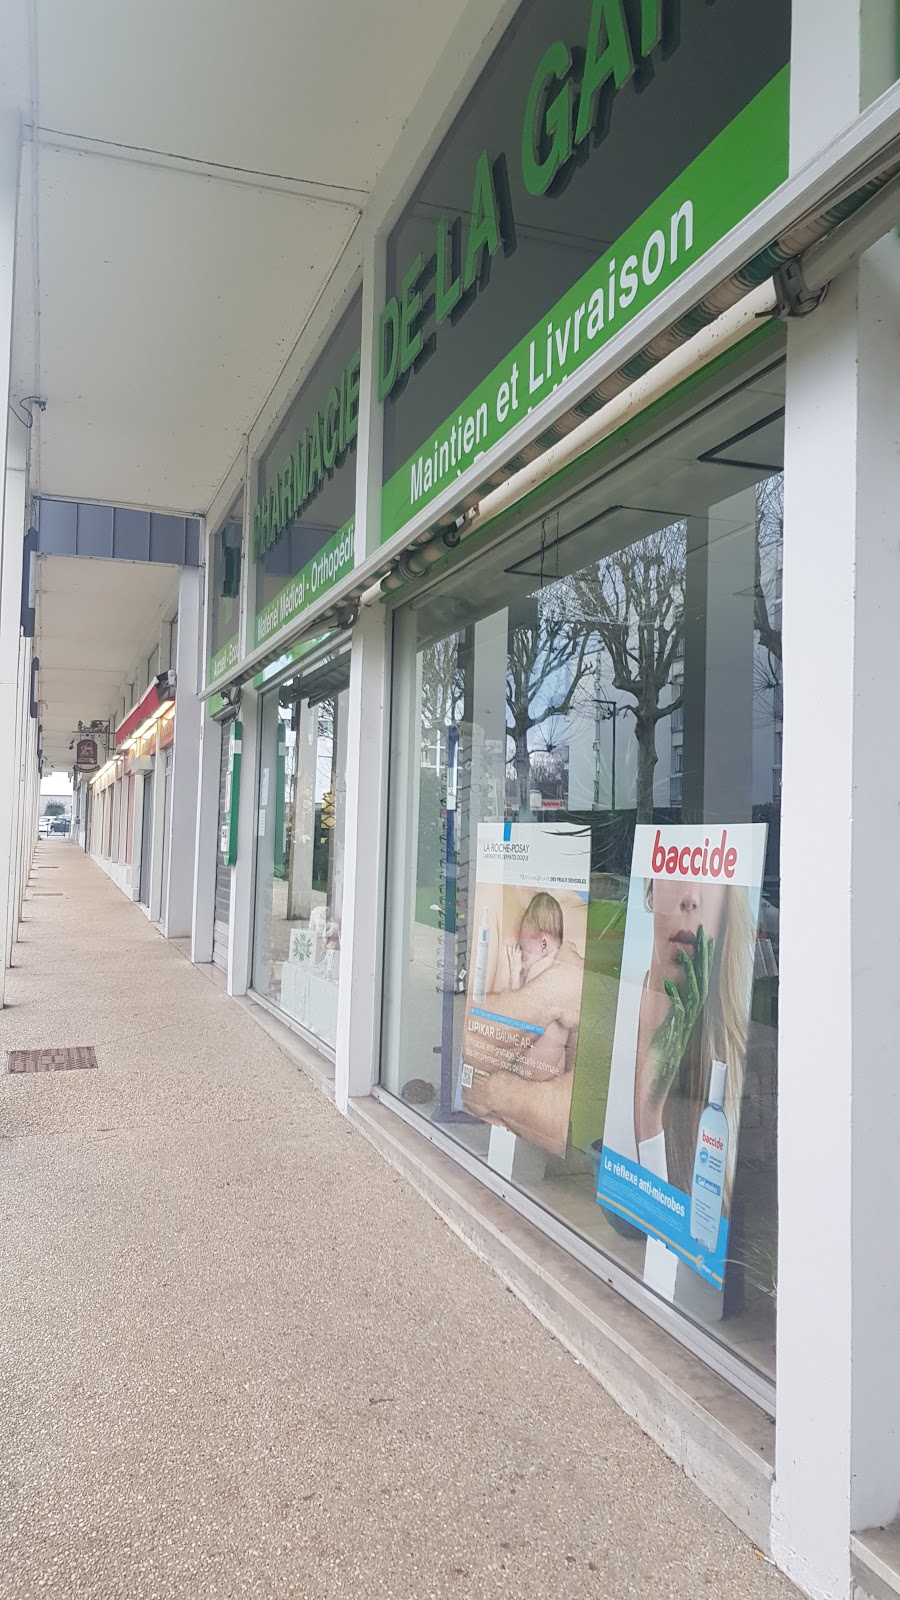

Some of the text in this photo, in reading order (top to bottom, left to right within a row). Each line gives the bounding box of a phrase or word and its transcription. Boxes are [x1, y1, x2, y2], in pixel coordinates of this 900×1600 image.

[253, 351, 360, 565] PHARMACIE
[379, 252, 424, 401] DE
[436, 150, 500, 326] LA
[410, 199, 695, 505] Maintien et Livraison
[280, 573, 305, 621] Médical
[311, 523, 355, 593] Orthopédi
[483, 843, 530, 853] LA ROCHE-POSAY
[651, 829, 738, 878] baccide
[468, 1019, 495, 1039] LIPIKAR
[495, 1028, 520, 1046] BAUME
[521, 1037, 535, 1049] AP+
[701, 1128, 724, 1151] baccide
[604, 1155, 612, 1171] Le
[613, 1162, 638, 1186] réflexe
[638, 1178, 685, 1217] anti-microbes
